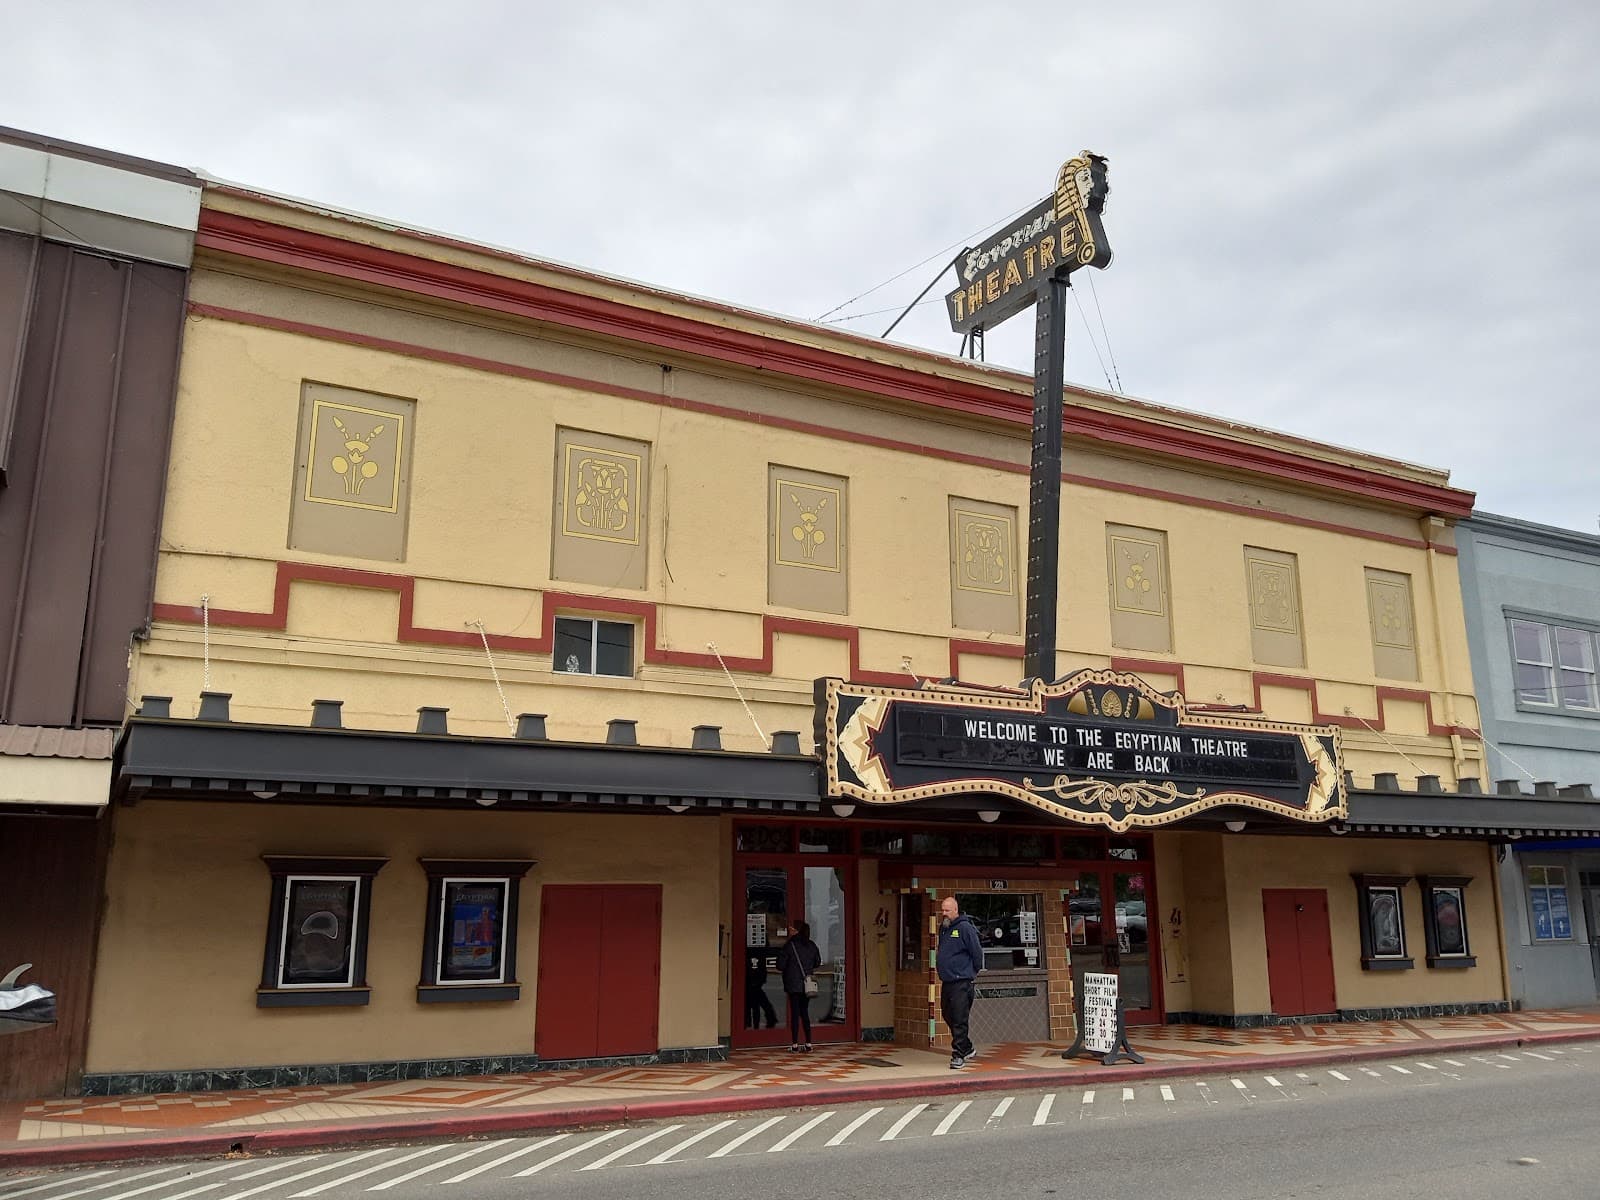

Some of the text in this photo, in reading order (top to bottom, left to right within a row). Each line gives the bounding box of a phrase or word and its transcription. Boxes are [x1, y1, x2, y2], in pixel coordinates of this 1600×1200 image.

[952, 220, 1077, 322] THEATRE
[964, 719, 1248, 758] WELCOME TO THE EGYPTIAN THEATRE
[1043, 748, 1170, 774] WE ARE BACK
[1085, 975, 1116, 985] MANHATTAN
[1084, 986, 1117, 997] SHORT FILM
[1088, 997, 1113, 1007] FESTIVAL
[1084, 1006, 1098, 1016] SEPT
[1100, 1008, 1107, 1018] 23
[1084, 1016, 1095, 1026] SEP
[1099, 1018, 1106, 1028] 24
[1084, 1028, 1095, 1037] SEP
[1099, 1029, 1107, 1038] 30
